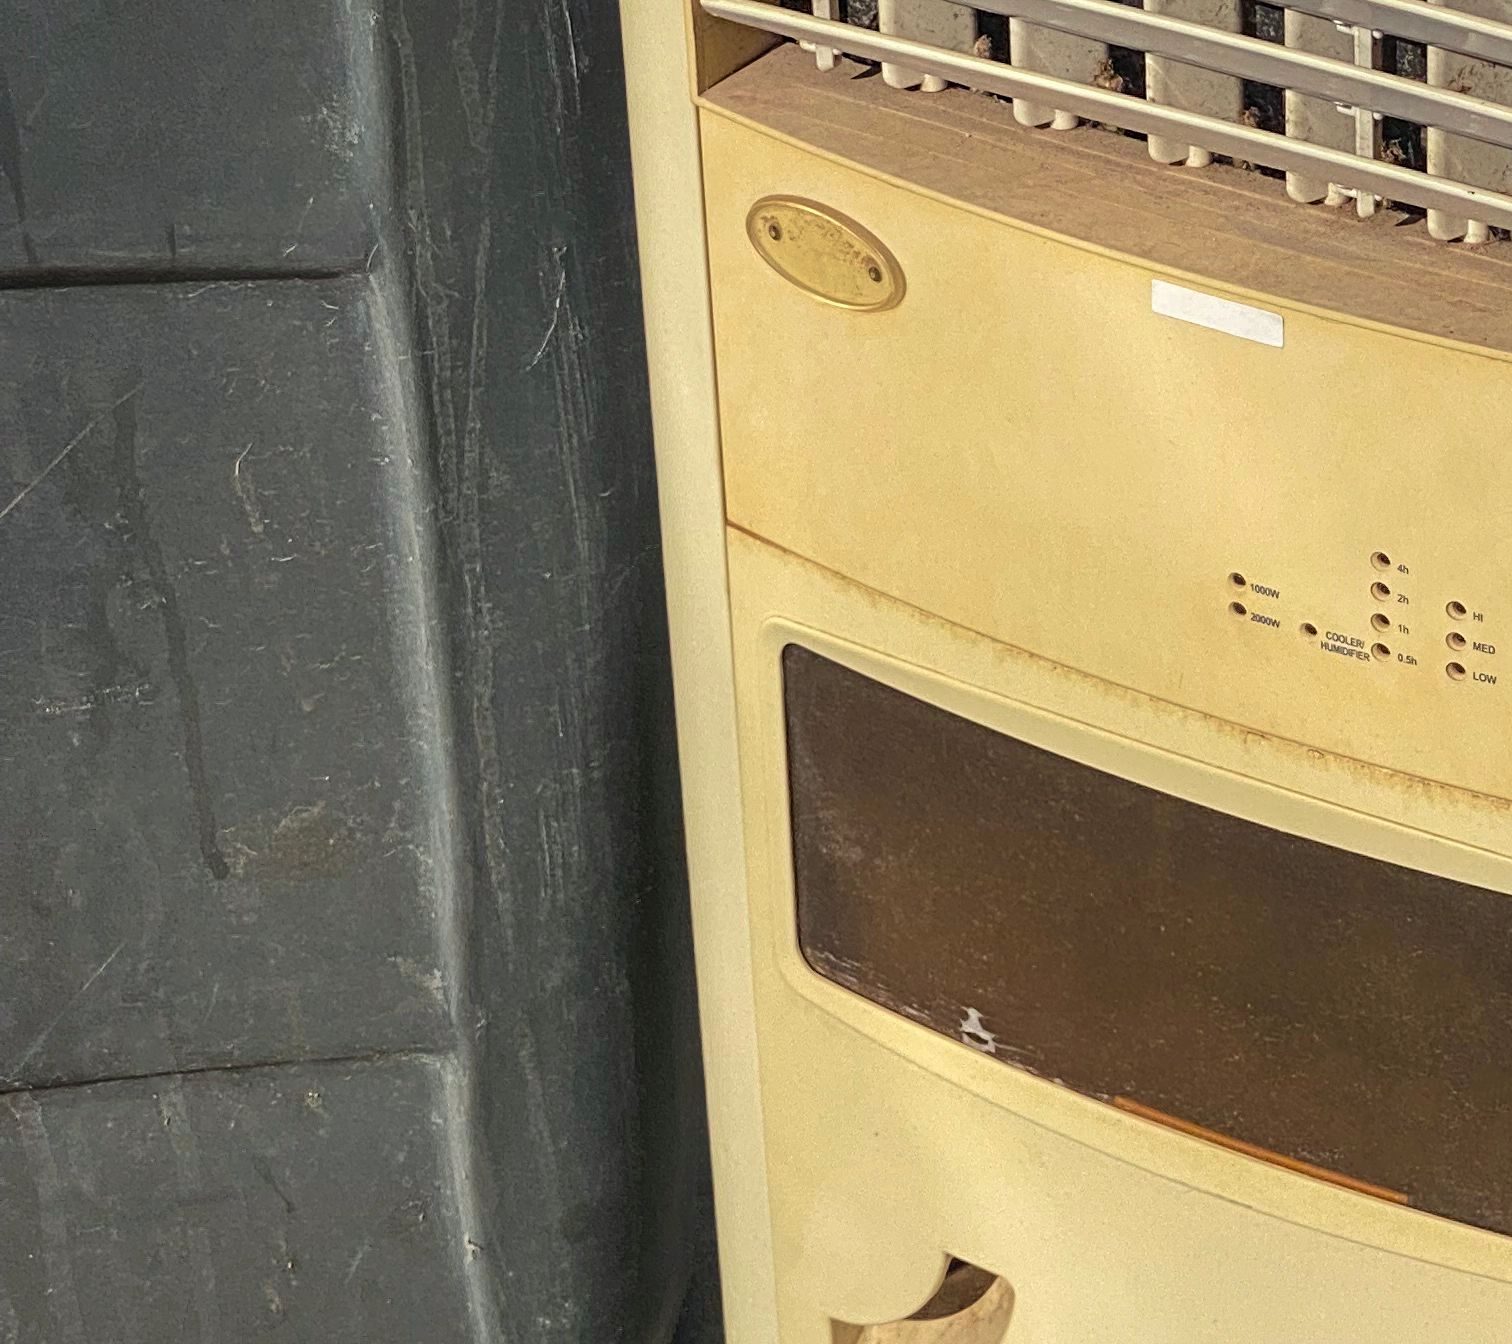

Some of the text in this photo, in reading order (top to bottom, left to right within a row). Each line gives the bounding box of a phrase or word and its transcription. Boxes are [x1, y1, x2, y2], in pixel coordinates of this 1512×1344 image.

[1397, 563, 1410, 575] 4h
[1250, 583, 1280, 600] 1000W
[1397, 593, 1410, 605] 2h
[1250, 612, 1281, 629] 2000W
[1472, 612, 1484, 623] HI
[1397, 623, 1410, 635] 1h
[1325, 631, 1365, 649] COOLER/
[1320, 641, 1371, 663] HUMIDIFIER
[1472, 641, 1496, 655] MED
[1397, 653, 1418, 666] 0.5h
[1472, 671, 1497, 685] LOW
